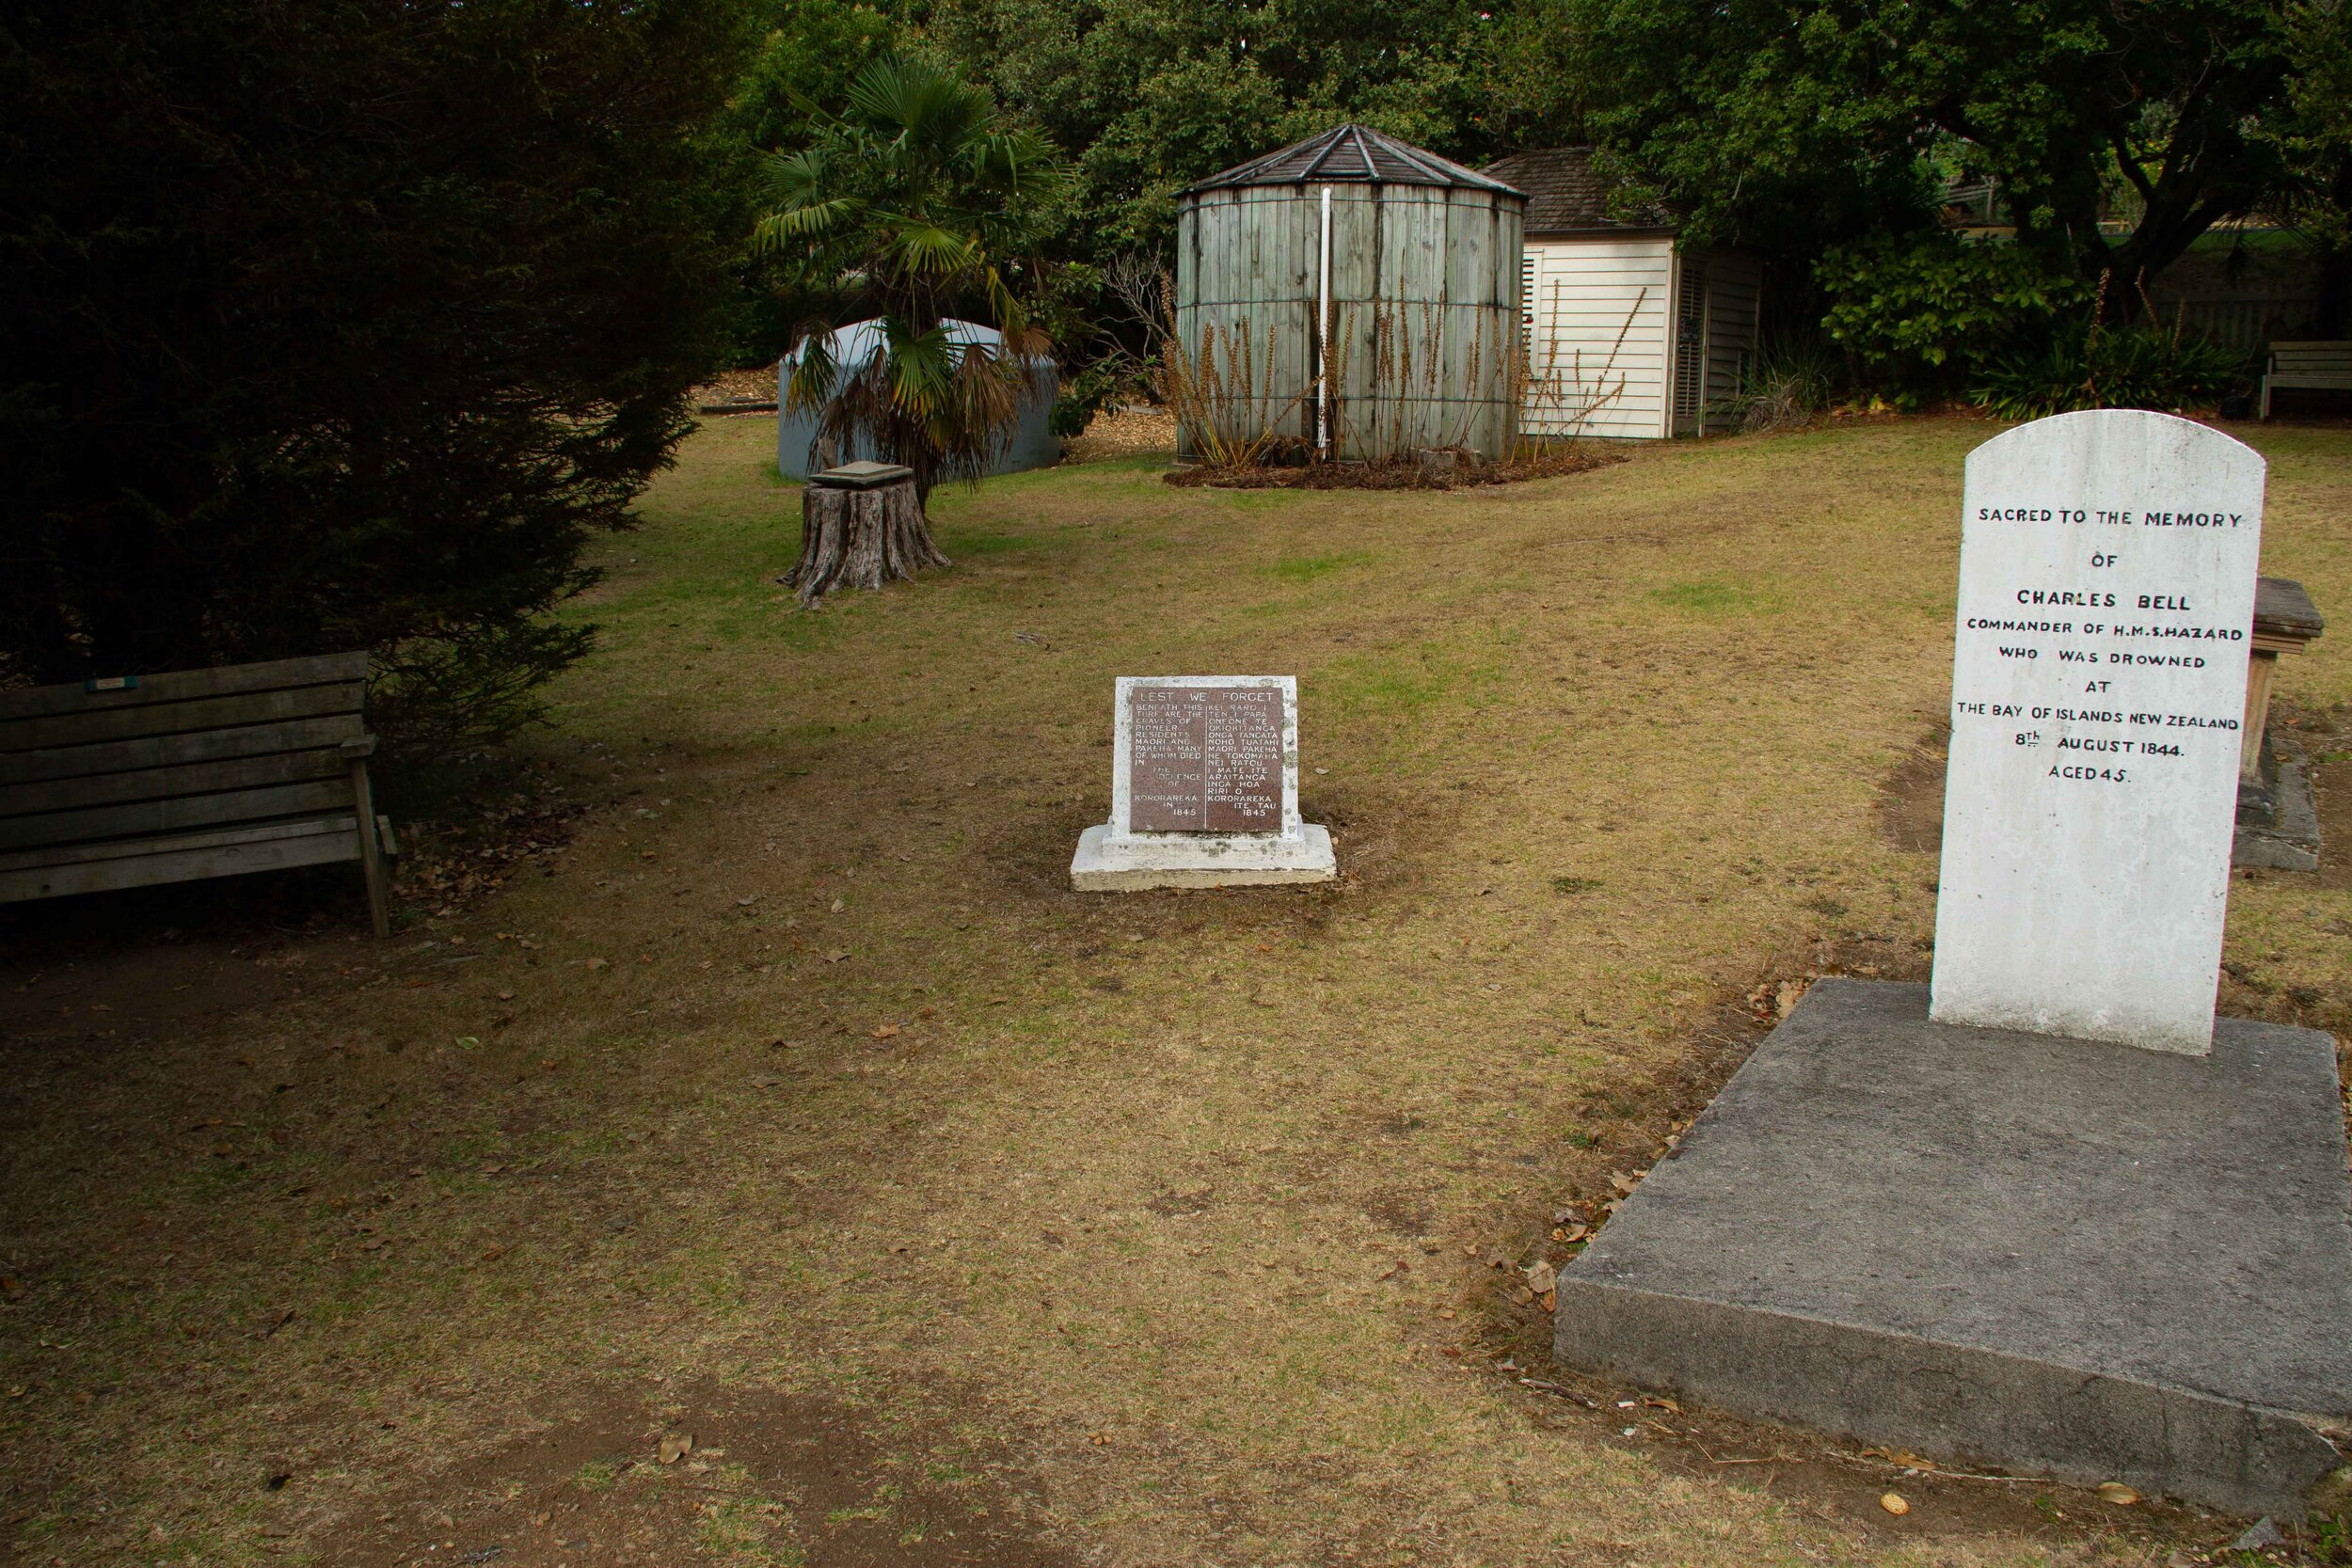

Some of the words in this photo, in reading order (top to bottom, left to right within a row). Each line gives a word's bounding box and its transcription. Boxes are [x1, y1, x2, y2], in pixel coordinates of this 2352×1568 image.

[1979, 509, 2052, 522] SACRED
[2059, 511, 2087, 523] TO
[2096, 512, 2132, 524] THE
[2145, 512, 2242, 528] MEMORY
[2091, 554, 2118, 567] OF
[2017, 590, 2116, 607] CHARLES
[2137, 595, 2190, 610] BELL
[1967, 619, 2072, 633] COMMANDER
[2084, 624, 2104, 634] OF
[1999, 646, 2038, 659] WHO
[2059, 651, 2098, 663] WAS
[2109, 654, 2205, 668] DROWNED
[2086, 681, 2111, 693] AT
[1140, 692, 1174, 701] LEST
[1190, 692, 1207, 702] WE
[1222, 692, 1274, 702] FORGET
[1957, 703, 1986, 715] THE
[1993, 705, 2023, 717] BAY
[2031, 707, 2052, 719] OF
[2057, 709, 2122, 723] ISLANDS
[2129, 713, 2162, 725] NEW
[2166, 715, 2238, 730] ZEALAND
[2058, 737, 2135, 752] AUGUST
[2141, 742, 2185, 756] 1844.
